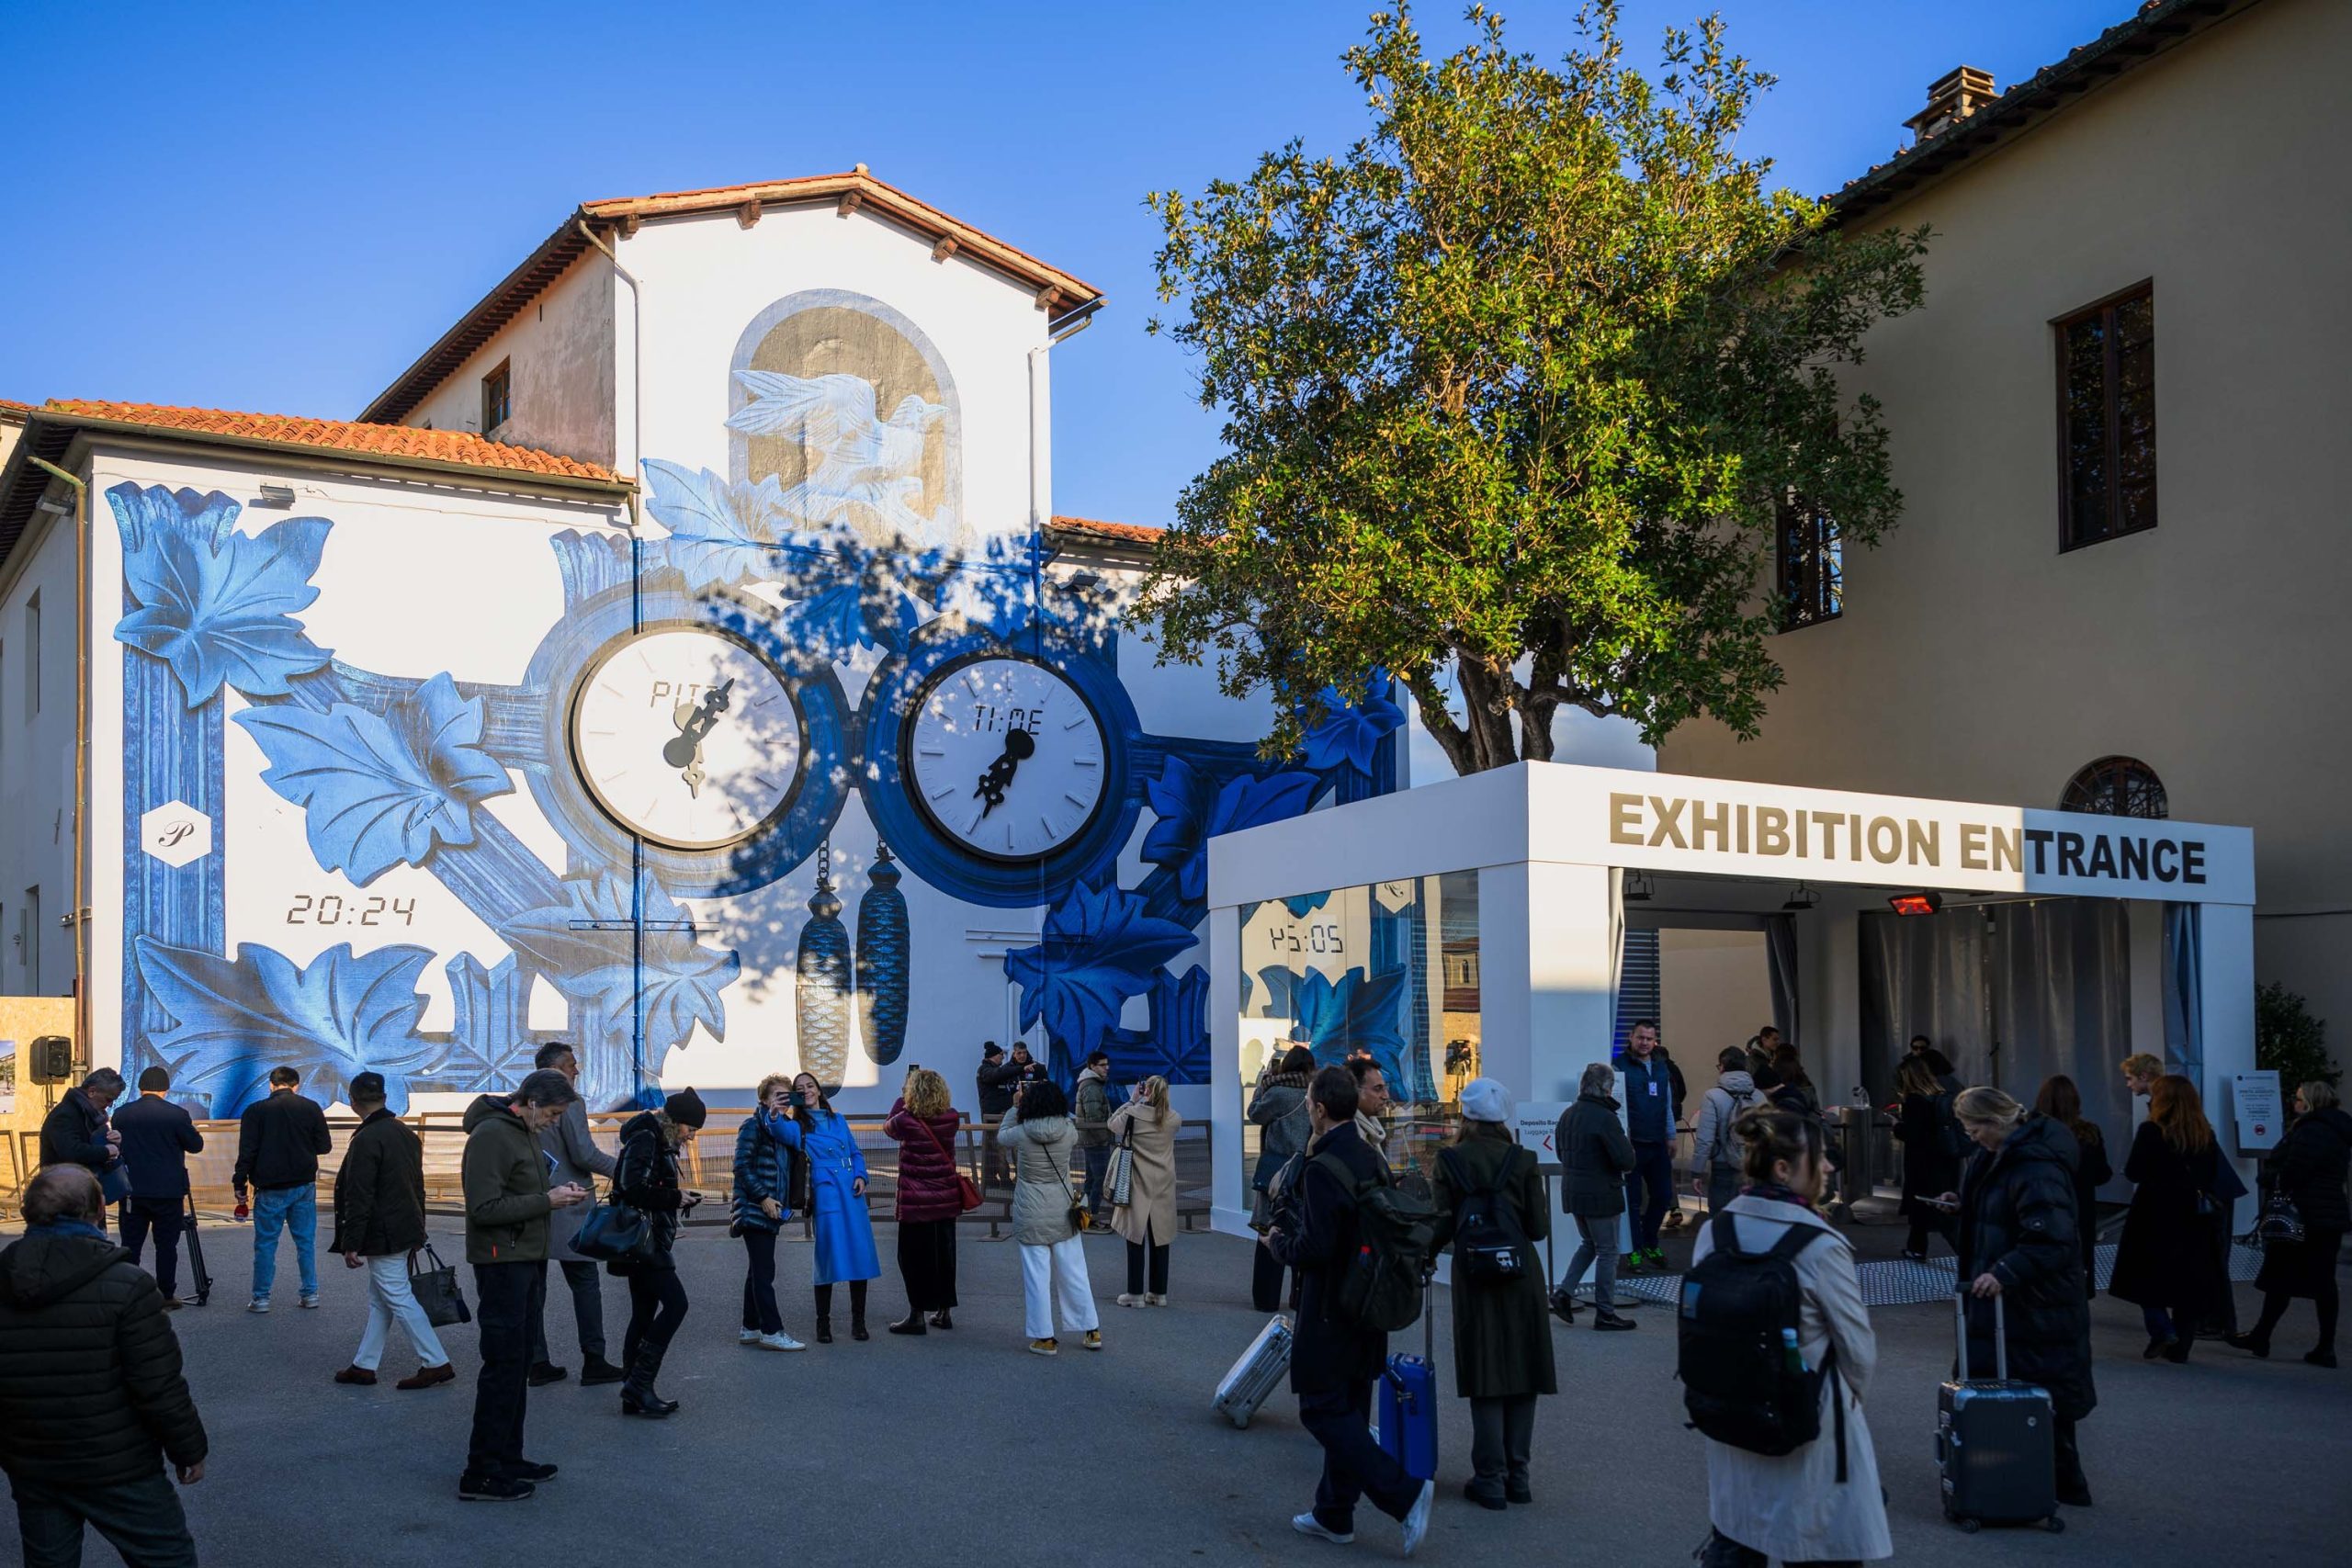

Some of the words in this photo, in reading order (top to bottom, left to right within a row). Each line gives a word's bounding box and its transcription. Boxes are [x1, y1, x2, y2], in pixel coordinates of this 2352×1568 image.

[650, 681, 718, 709] PIT
[1610, 792, 1940, 867] EXHIBITION
[1960, 823, 2206, 885] ENTRANCE
[287, 895, 415, 926] 20:24
